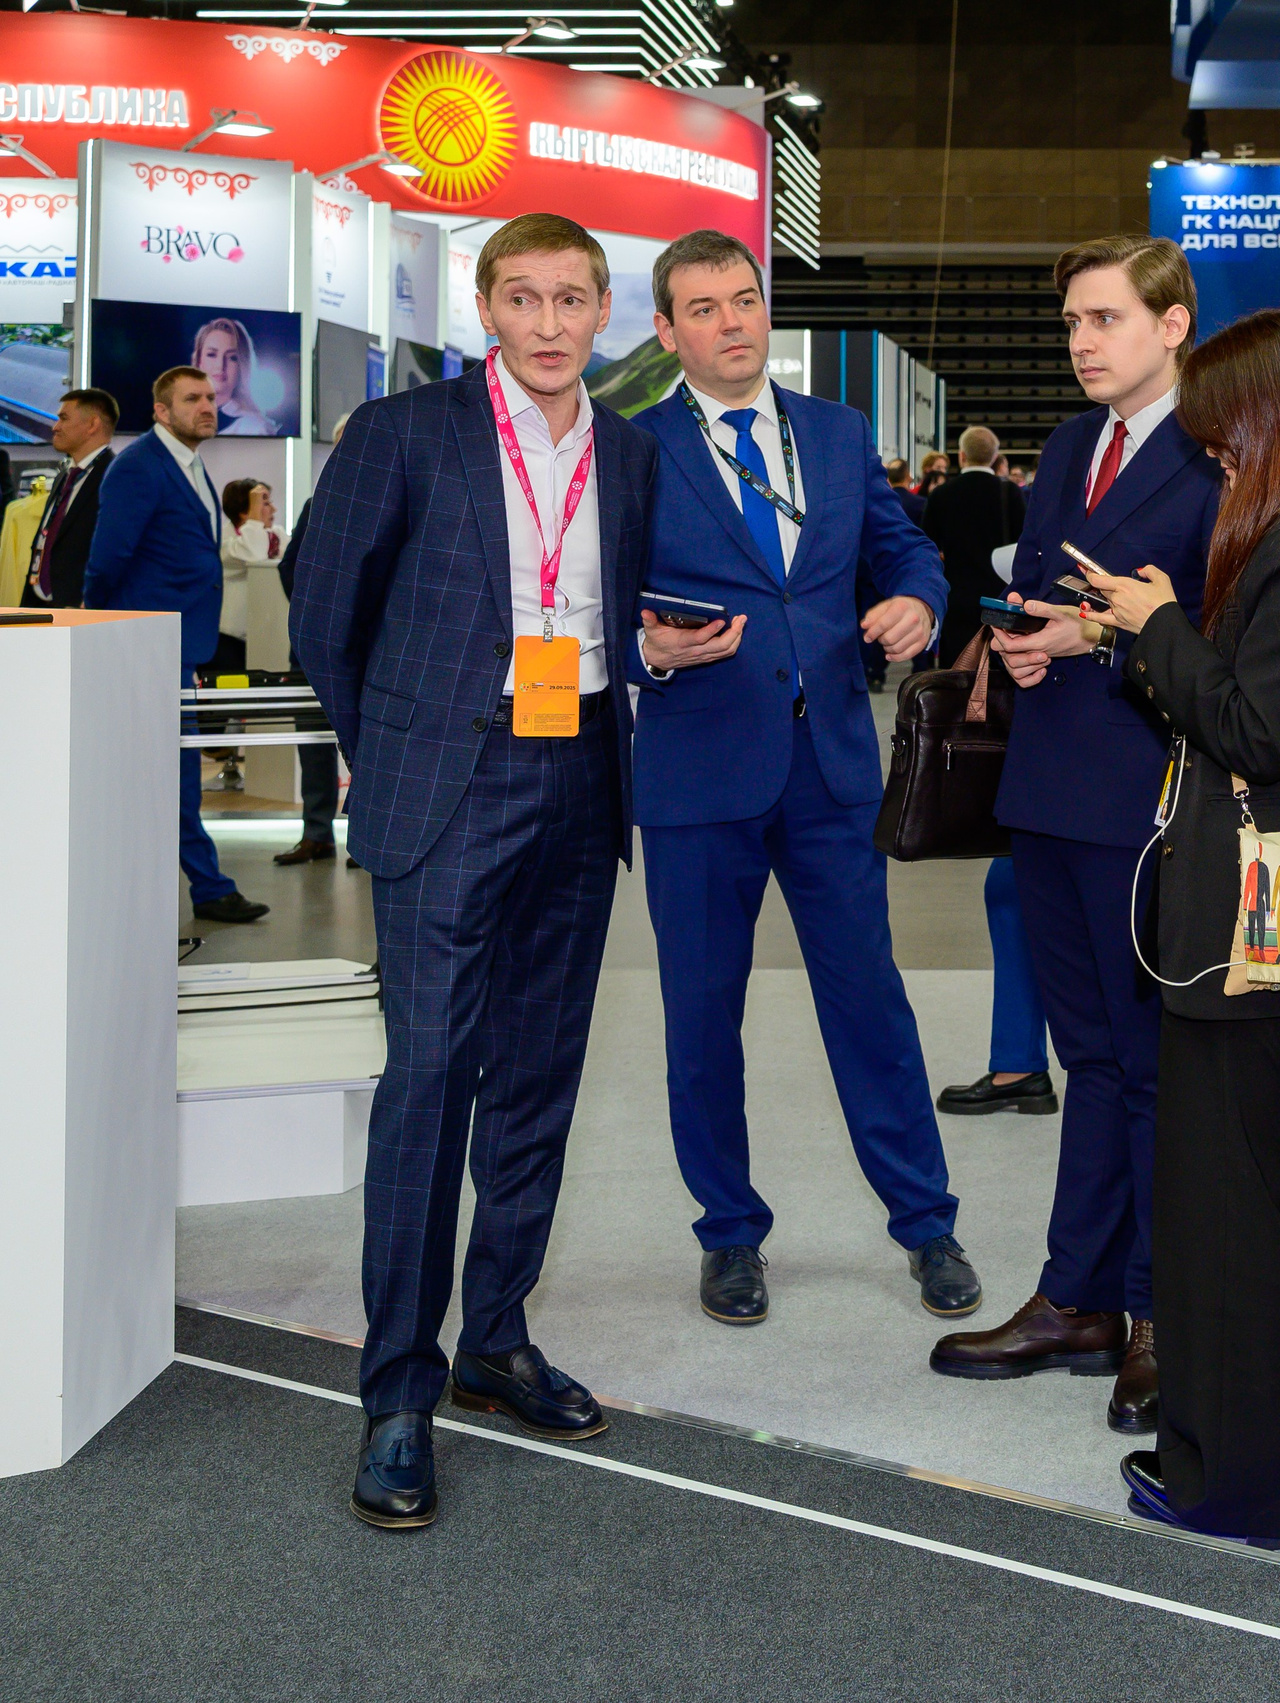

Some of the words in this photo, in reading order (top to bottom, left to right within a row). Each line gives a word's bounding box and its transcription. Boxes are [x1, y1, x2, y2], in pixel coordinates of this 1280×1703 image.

[1181, 214, 1213, 230] ГК
[144, 225, 241, 262] BRAVO
[1180, 234, 1238, 251] ДЛЯ
